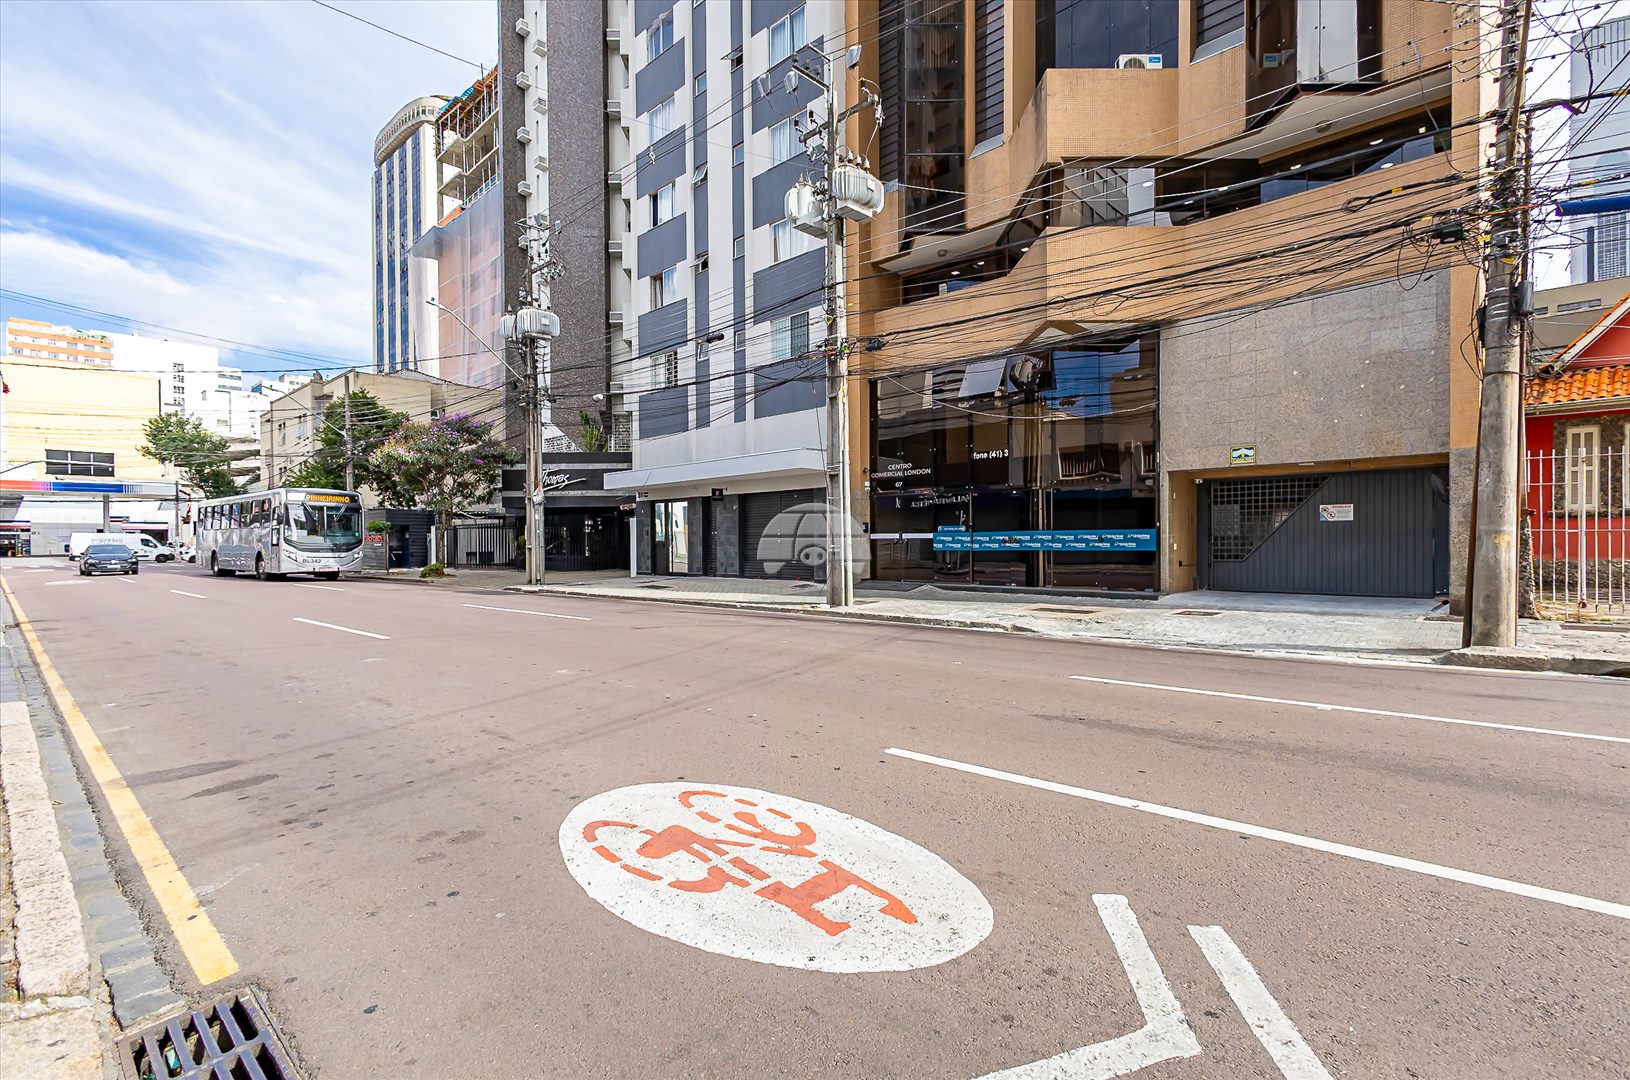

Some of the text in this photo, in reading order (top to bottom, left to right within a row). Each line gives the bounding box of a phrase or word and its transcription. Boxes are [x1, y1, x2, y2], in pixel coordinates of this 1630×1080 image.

[988, 449, 1003, 459] (41)
[887, 462, 912, 470] CENTRO
[904, 468, 931, 476] LONDON
[305, 494, 350, 503] PINHEIRINHO
